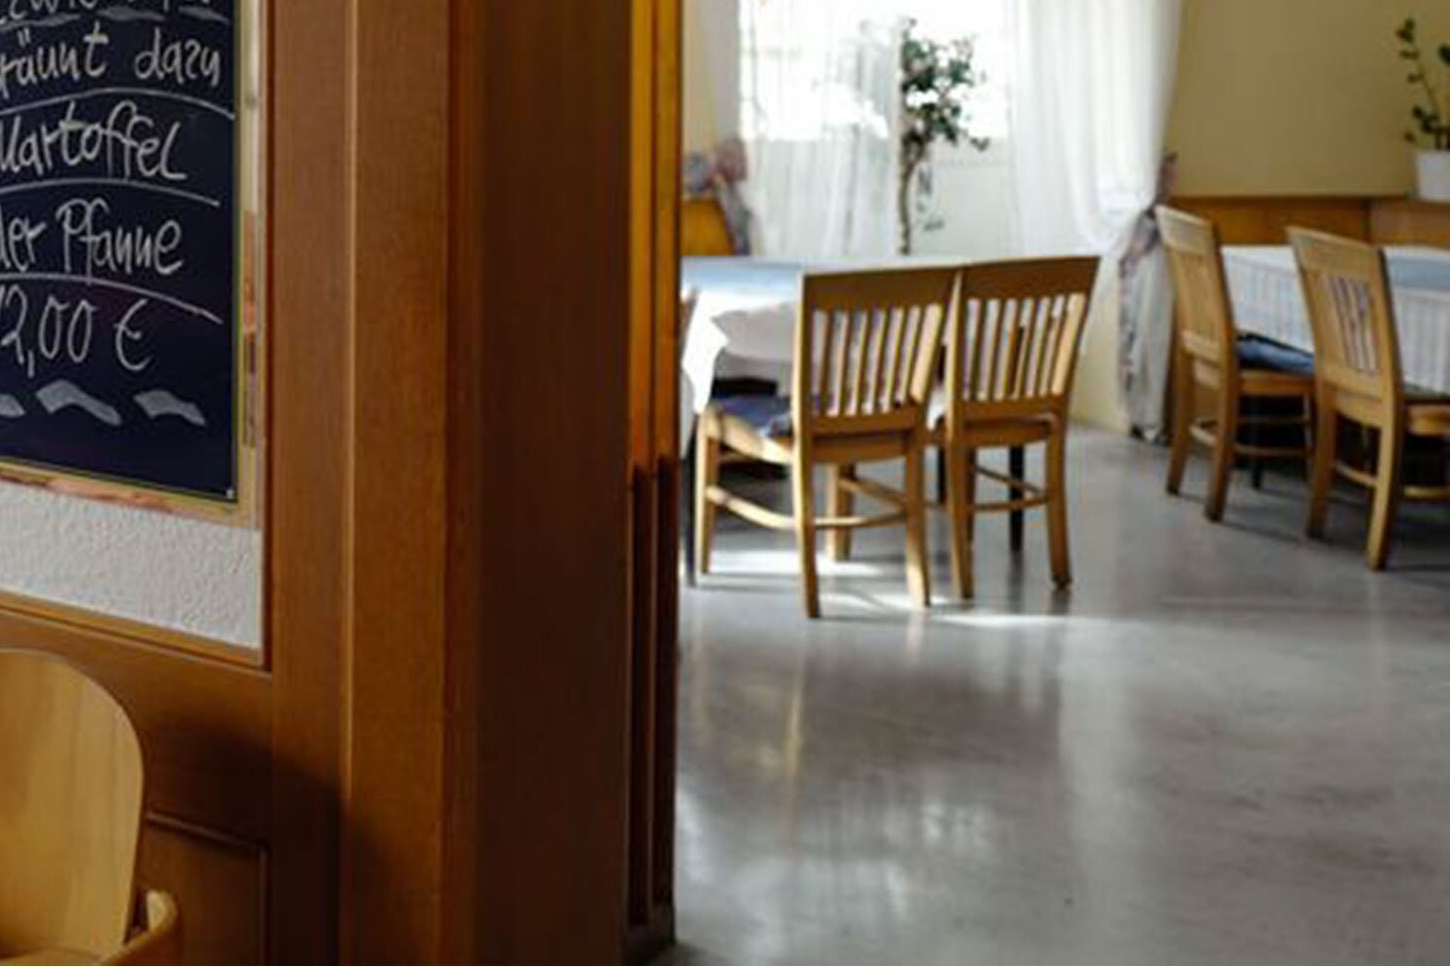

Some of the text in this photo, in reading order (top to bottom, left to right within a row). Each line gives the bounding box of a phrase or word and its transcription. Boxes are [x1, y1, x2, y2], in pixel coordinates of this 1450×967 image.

[134, 27, 220, 87] dazu
[55, 198, 183, 285] Pfanne
[113, 298, 150, 371] €
